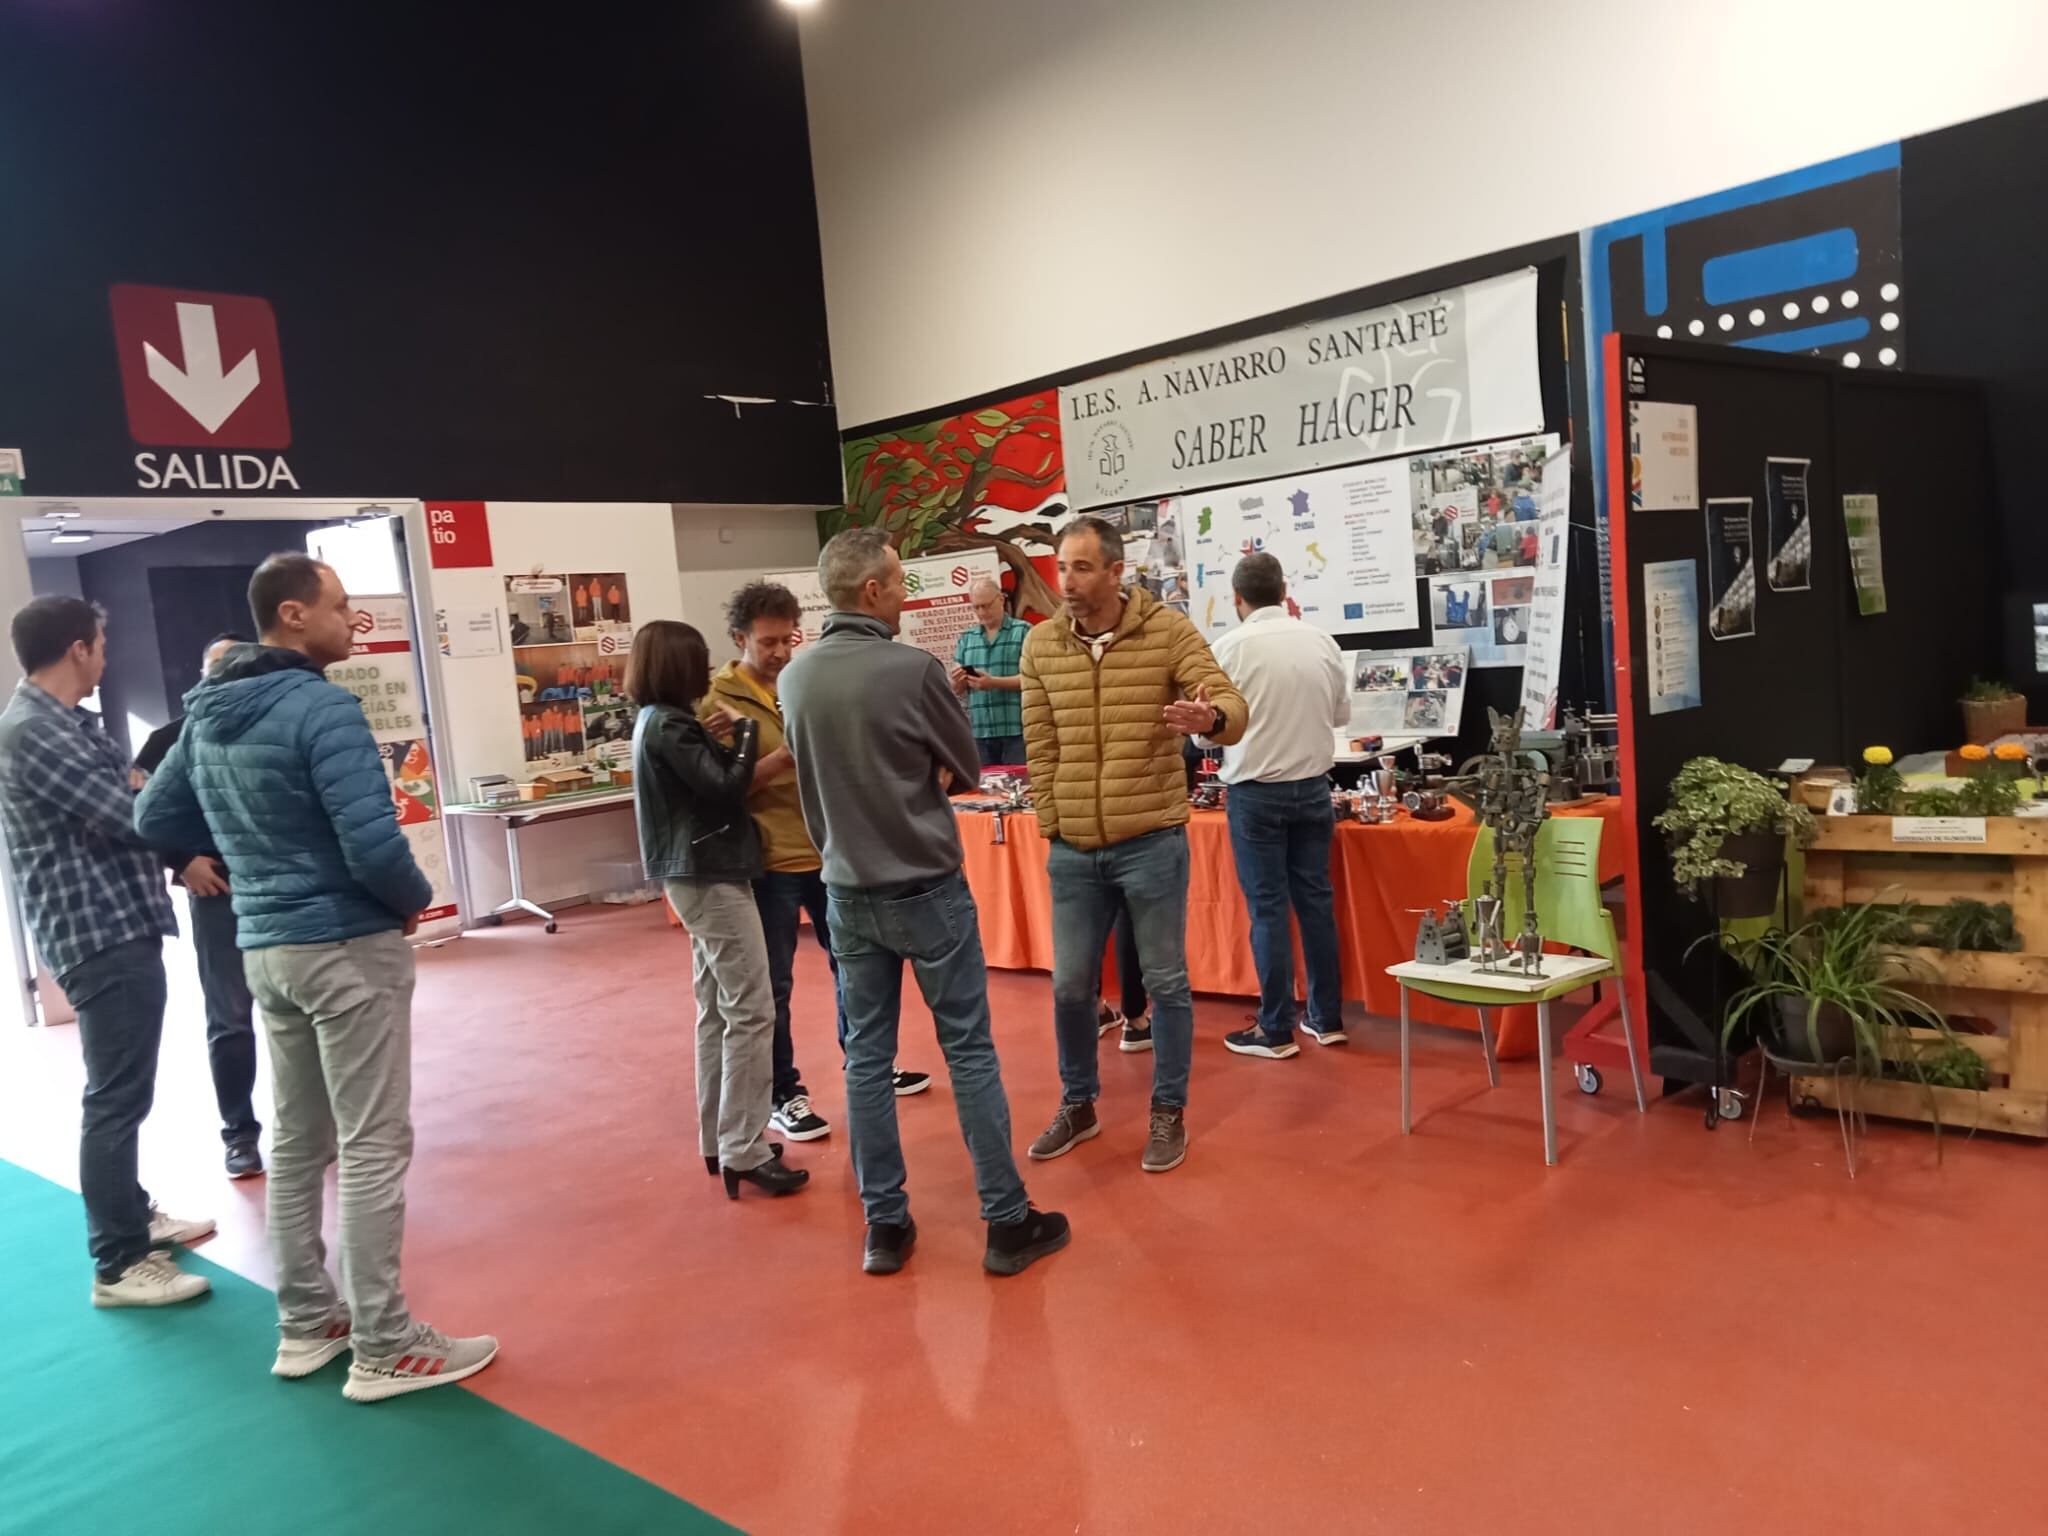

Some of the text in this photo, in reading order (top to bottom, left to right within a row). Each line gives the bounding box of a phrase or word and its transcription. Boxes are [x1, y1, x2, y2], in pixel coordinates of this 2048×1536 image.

[1071, 296, 1448, 420] I.E.S. A. NAVARRO SANTAFÉ
[1172, 383, 1415, 470] SABER HACER
[134, 452, 301, 489] SALIDA
[430, 509, 455, 526] pa
[432, 527, 456, 544] tio
[928, 594, 965, 607] VILLENA
[936, 613, 975, 625] SISTEMAS
[385, 681, 407, 695] EN
